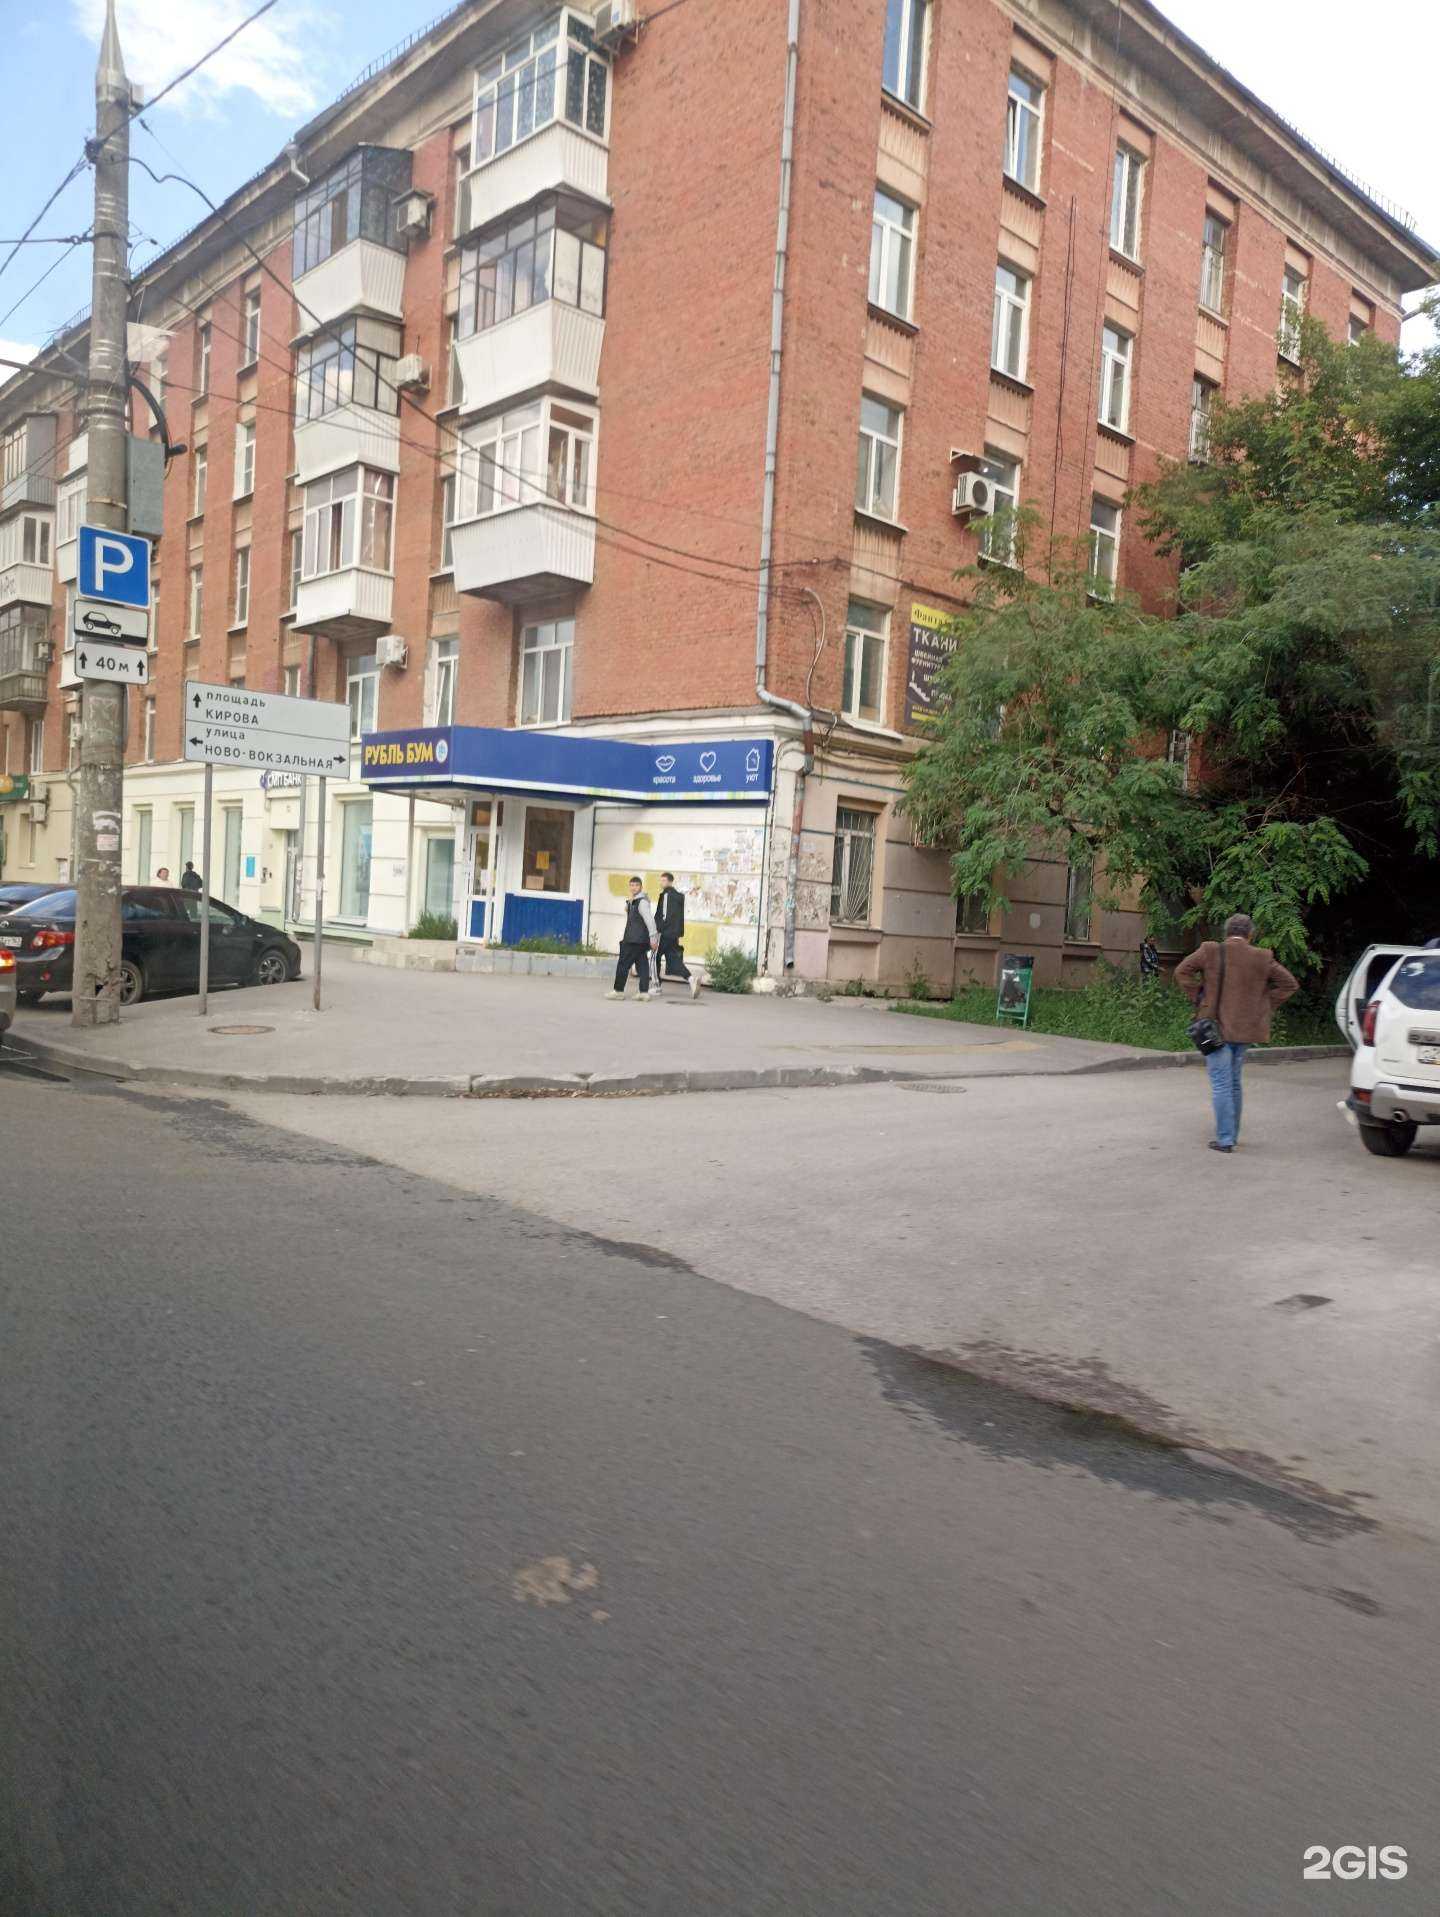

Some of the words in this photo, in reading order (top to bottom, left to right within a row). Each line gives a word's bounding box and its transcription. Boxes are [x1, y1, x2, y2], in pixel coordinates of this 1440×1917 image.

[95, 536, 134, 592] P
[913, 627, 957, 652] ТКАНИ
[96, 657, 116, 670] 40
[206, 692, 266, 708] площадь
[205, 709, 259, 725] КИРОВА
[206, 728, 245, 740] улица
[205, 744, 333, 769] НОВО-ВОКЗАЛЬНАЯ
[365, 744, 404, 766] РУБЛЬ
[406, 742, 434, 763] БУМ
[653, 776, 676, 784] красота
[693, 775, 722, 784] здоровье
[746, 774, 759, 783] уют
